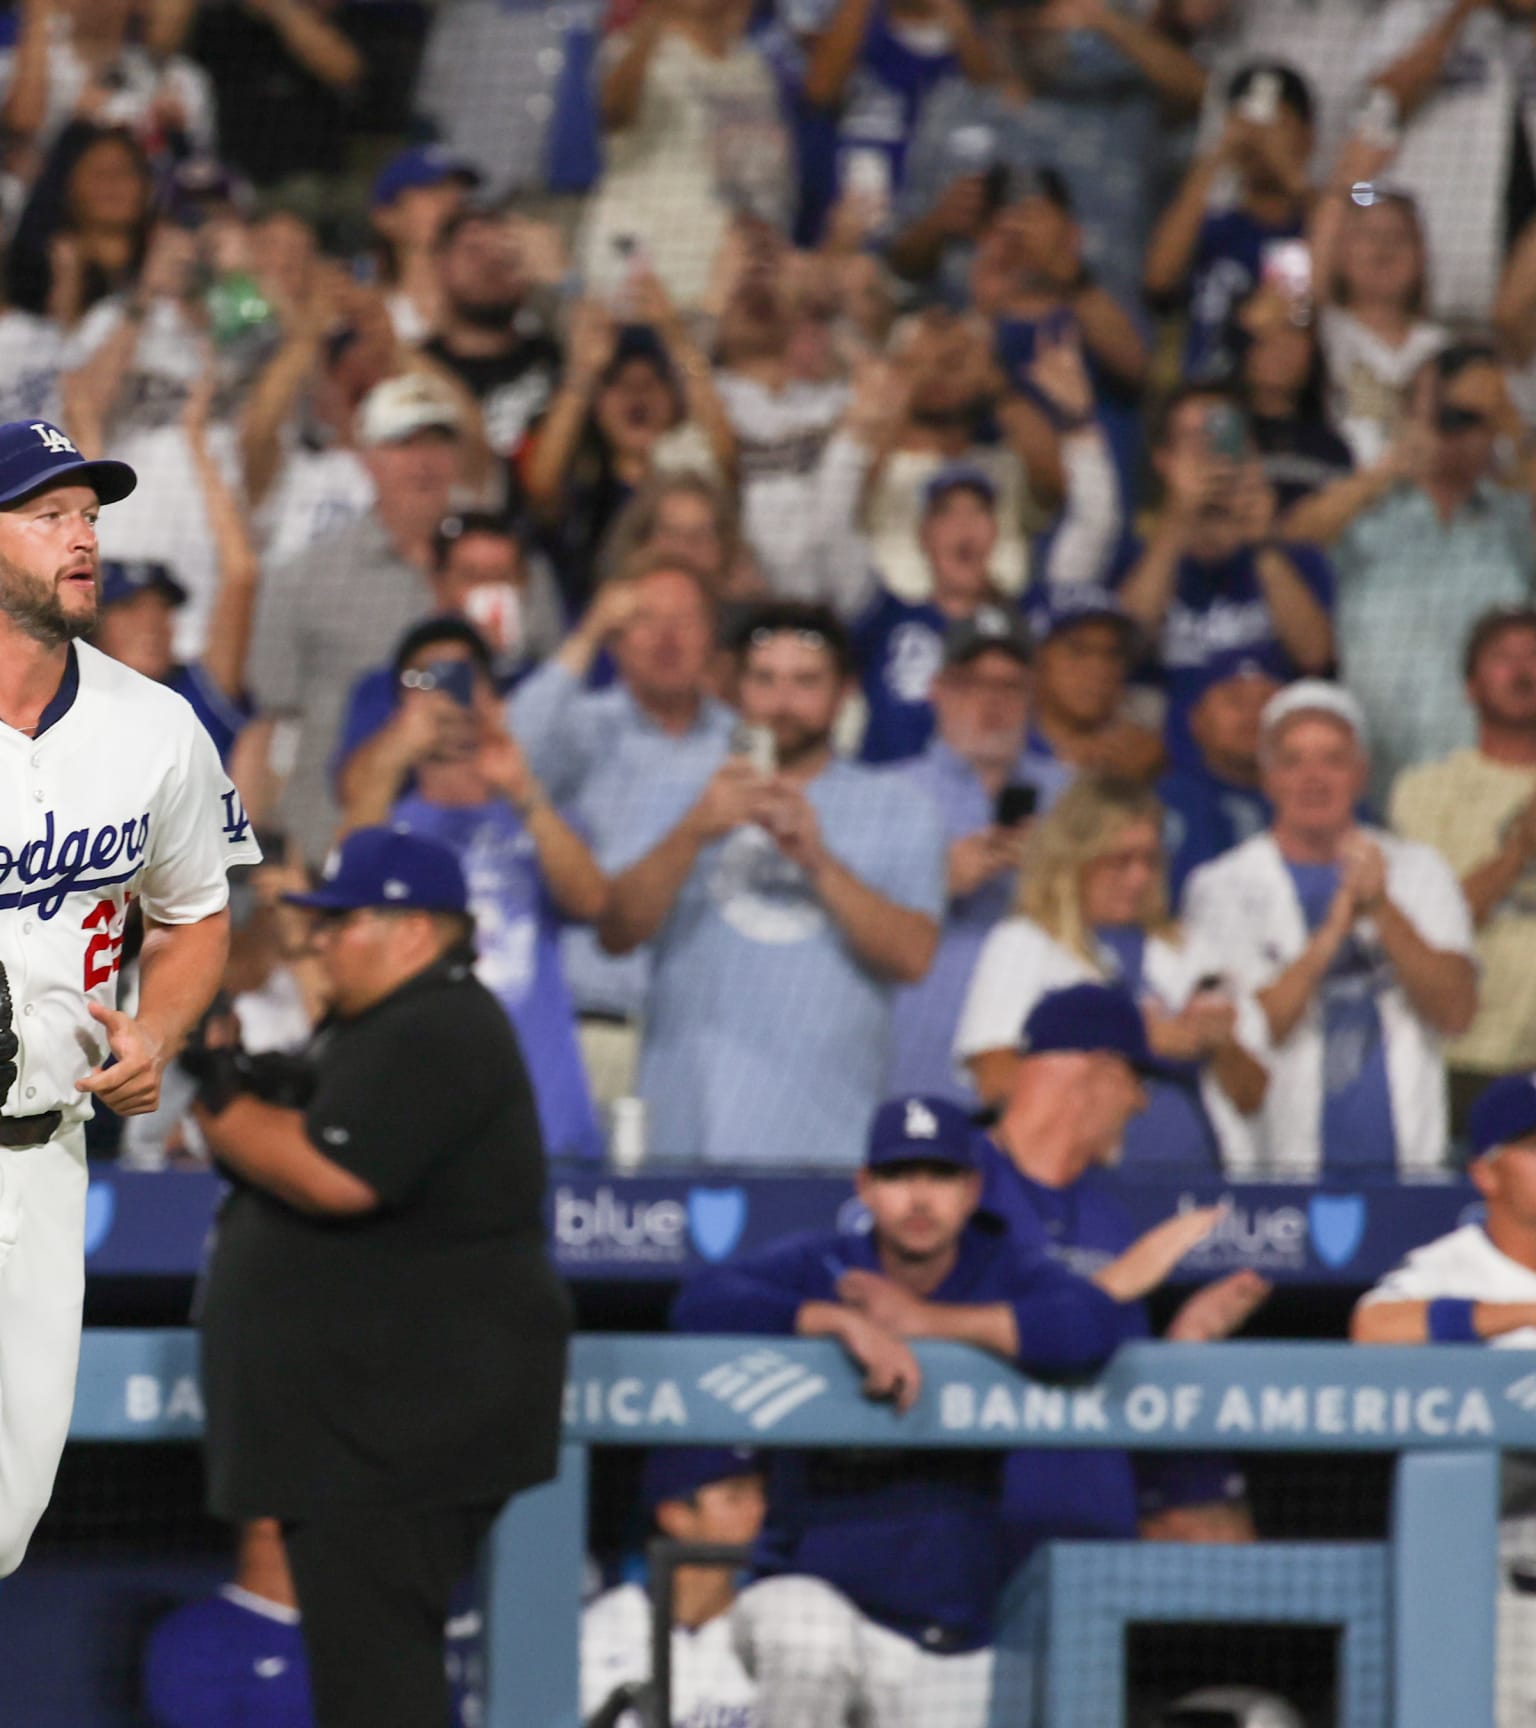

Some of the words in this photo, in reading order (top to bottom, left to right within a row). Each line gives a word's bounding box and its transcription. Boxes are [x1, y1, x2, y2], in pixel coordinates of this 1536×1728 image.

[29, 423, 77, 453] LA
[555, 1187, 685, 1246] blue
[125, 1374, 205, 1422] BA
[940, 1384, 1109, 1431] BANK
[1124, 1385, 1202, 1432] OF
[1215, 1386, 1495, 1435] AMERICA
